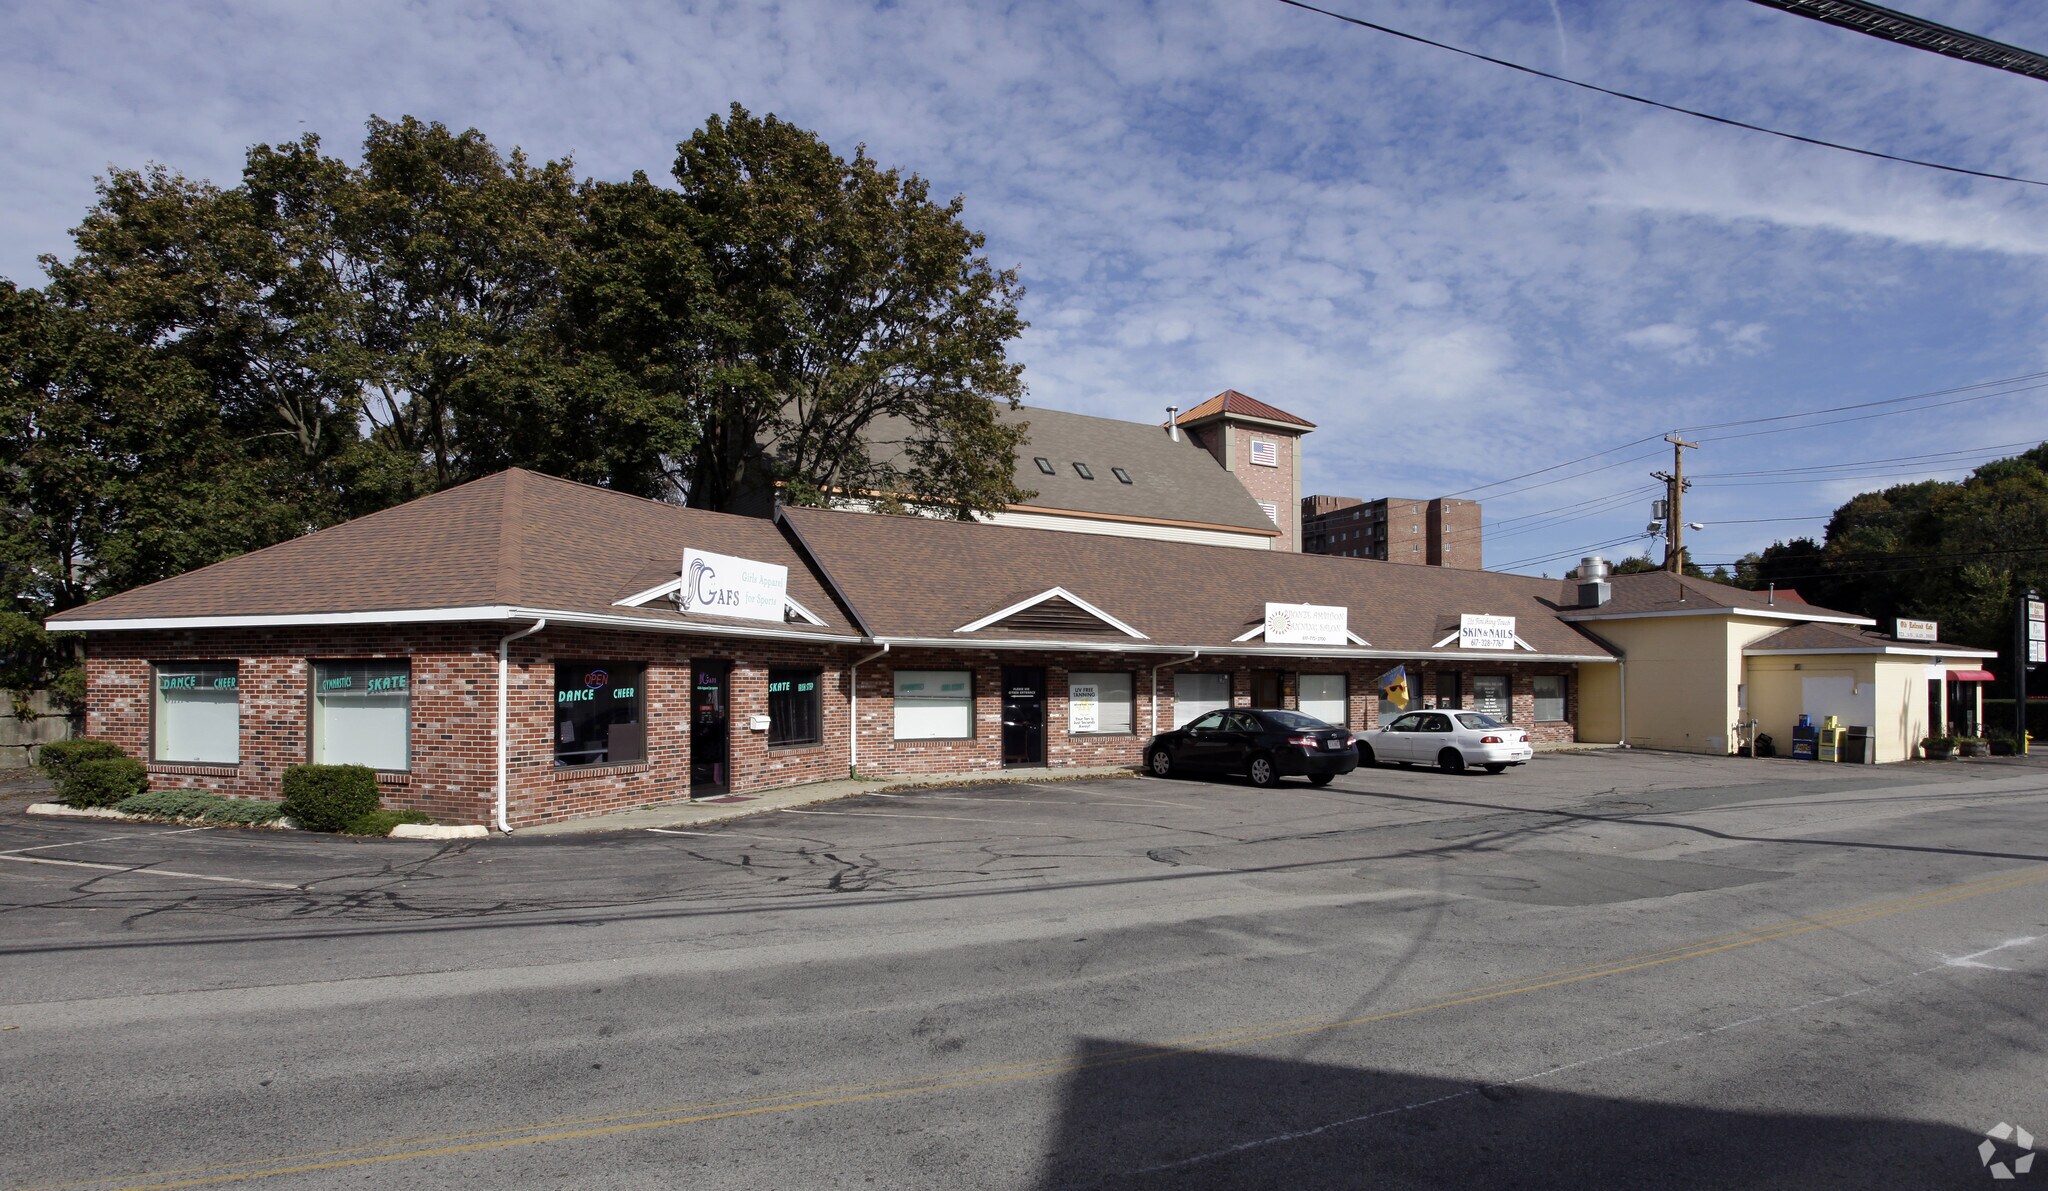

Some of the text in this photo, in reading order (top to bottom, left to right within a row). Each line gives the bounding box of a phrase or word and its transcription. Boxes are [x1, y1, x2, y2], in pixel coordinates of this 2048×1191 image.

[742, 571, 784, 589] Girls Apparel
[745, 591, 777, 607] for Sports
[1320, 623, 1341, 633] SALON
[1462, 627, 1482, 638] SKIN
[1489, 628, 1513, 639] NAILS
[163, 676, 236, 690] DANCE CHEER
[367, 675, 406, 691] SKATE
[584, 674, 609, 685] OPEN
[769, 681, 790, 692] SKATE
[558, 687, 634, 703] DANCE CHEER
